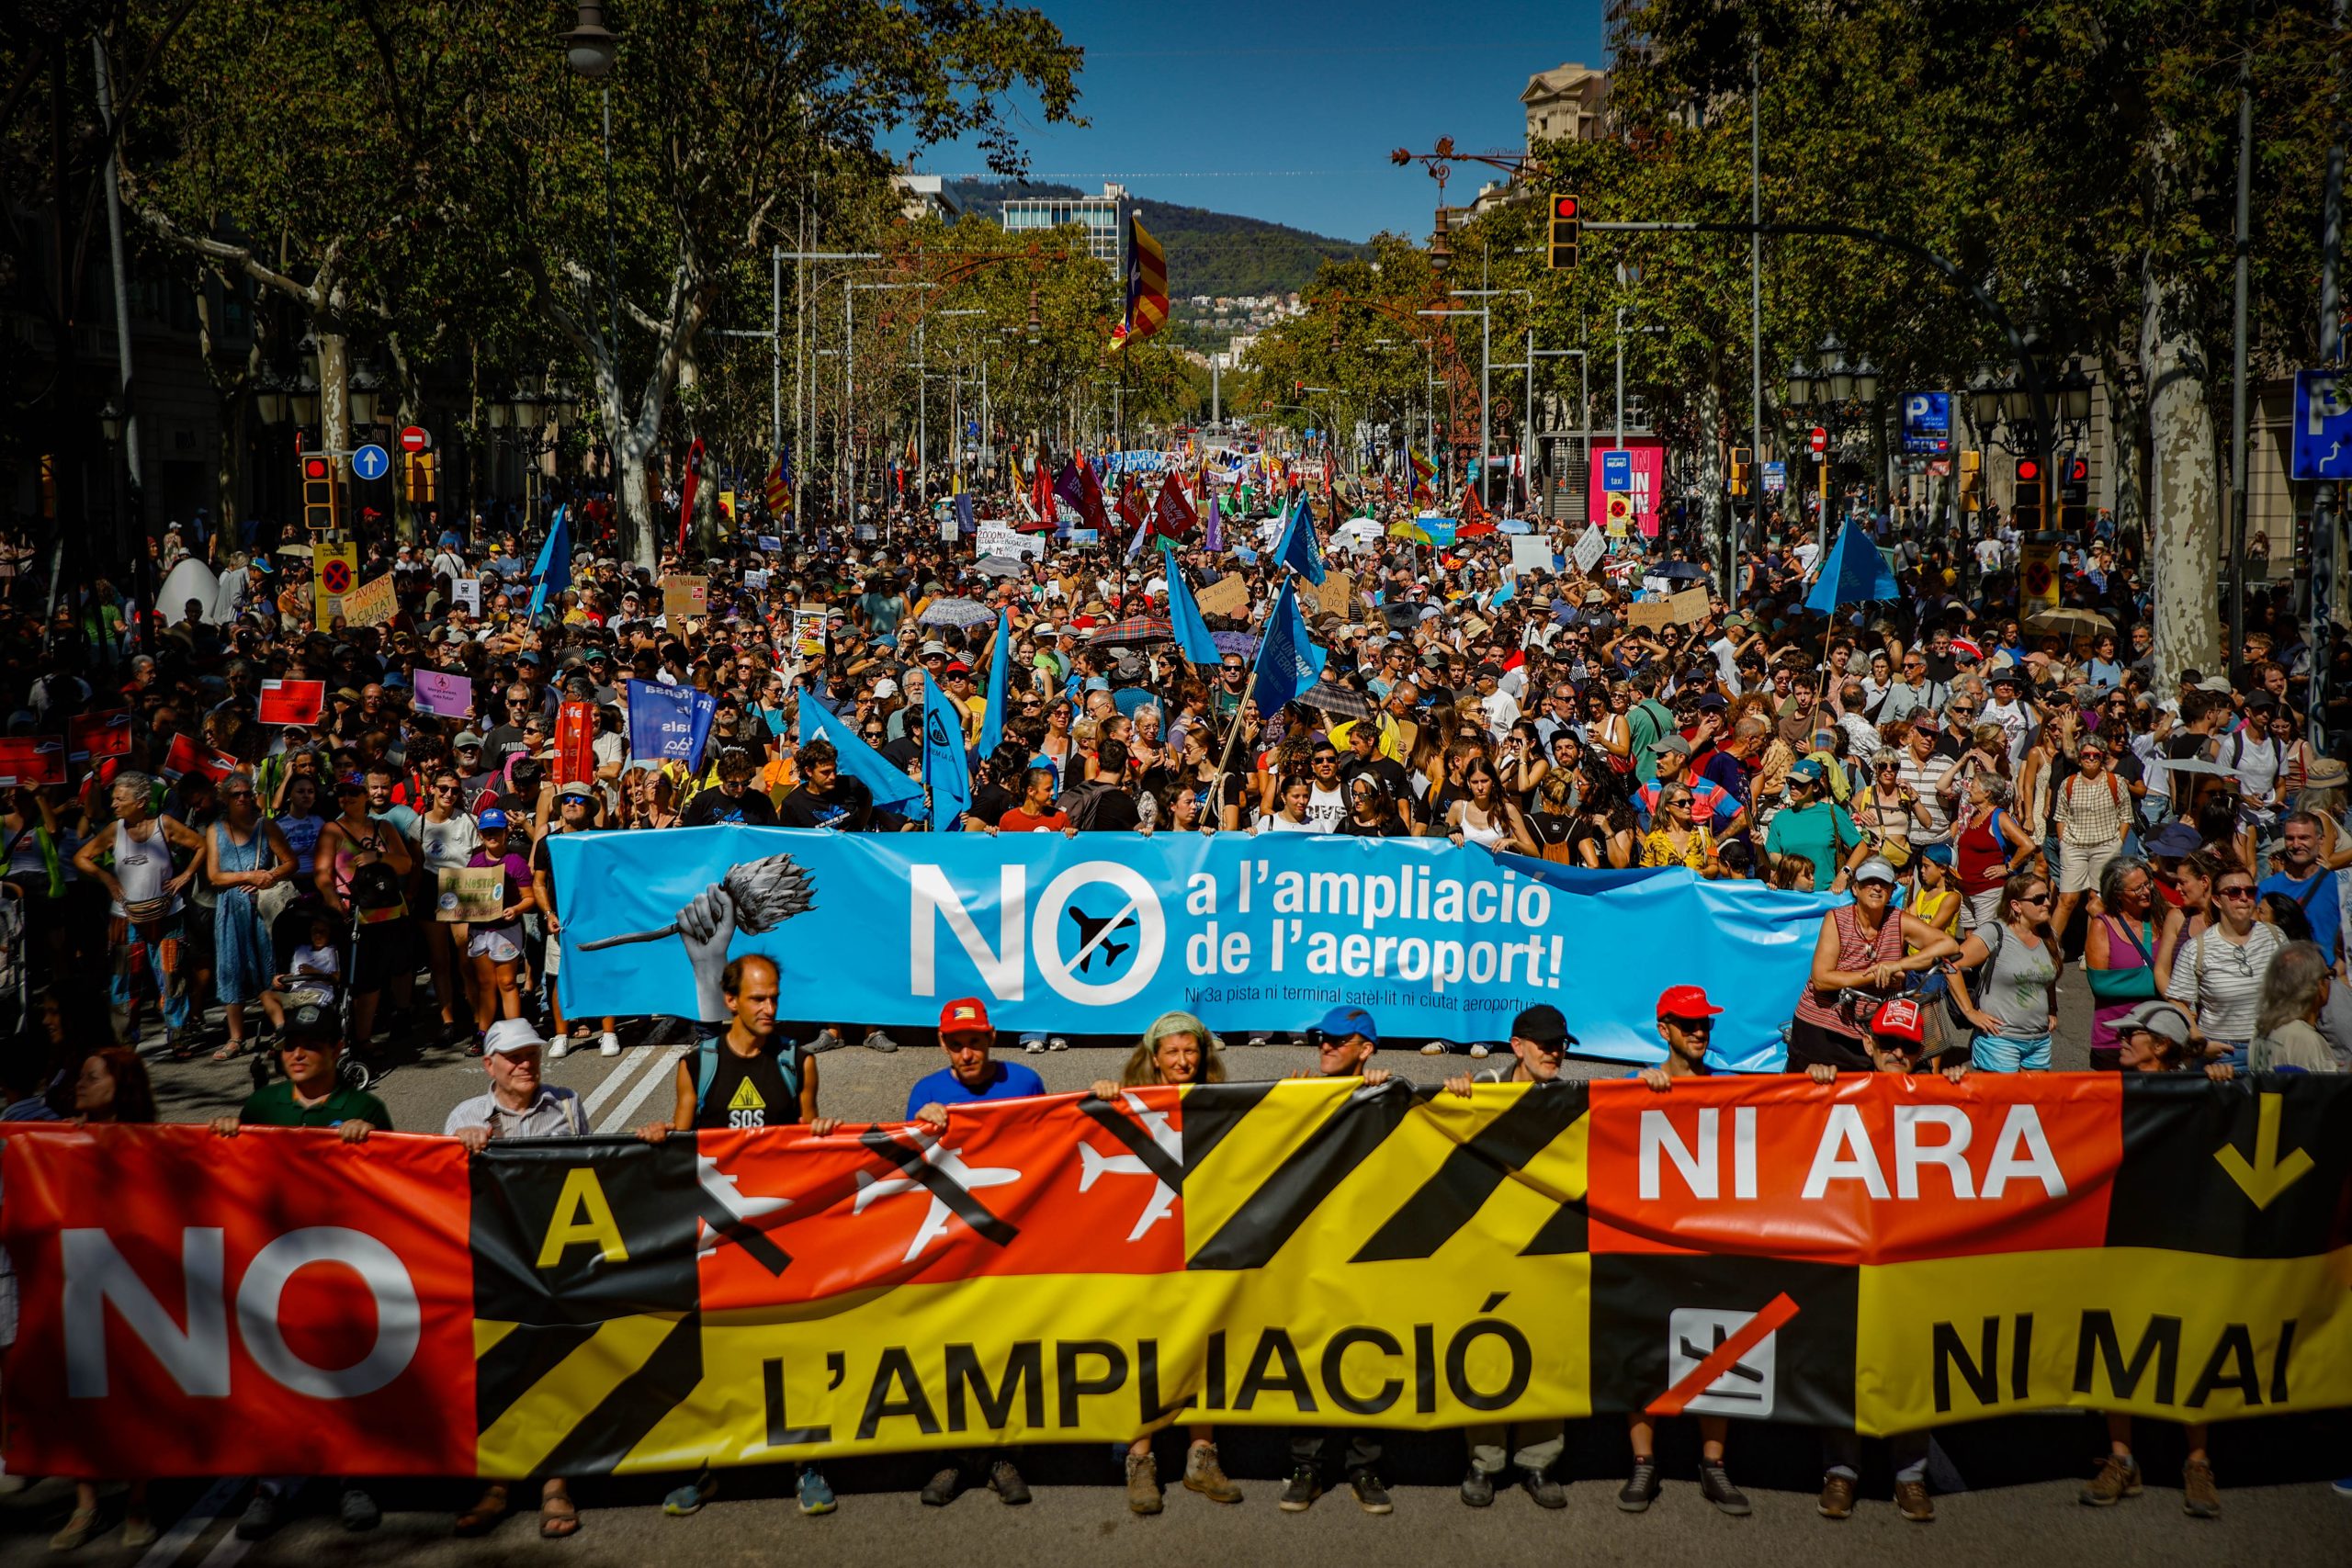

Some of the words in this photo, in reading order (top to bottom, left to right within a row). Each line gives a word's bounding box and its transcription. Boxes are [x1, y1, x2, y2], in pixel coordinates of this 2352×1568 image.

[1905, 396, 1929, 426] P
[2308, 378, 2352, 435] P
[1611, 477, 1623, 485] taxi
[355, 575, 390, 600] AVIONS
[357, 594, 391, 622] CIUTAT
[1185, 871, 1216, 916] a
[910, 861, 1167, 1007] NO
[1185, 920, 1250, 976] de
[1184, 987, 1200, 1003] Ni
[1204, 987, 1223, 1002] 3a
[1227, 987, 1260, 1005] pista
[1265, 986, 1278, 1000] ni
[1282, 985, 1341, 1003] terminal
[1345, 987, 1397, 1006] satèl·lit
[1402, 990, 1415, 1007] ni
[1419, 990, 1459, 1010] ciutat
[728, 1109, 765, 1129] SOS
[1638, 1105, 1758, 1201] NI
[1801, 1103, 2069, 1201] ARA
[536, 1168, 629, 1269] A
[60, 1225, 422, 1401] NO
[1932, 1313, 2033, 1414] NI
[2072, 1311, 2299, 1410] MAI
